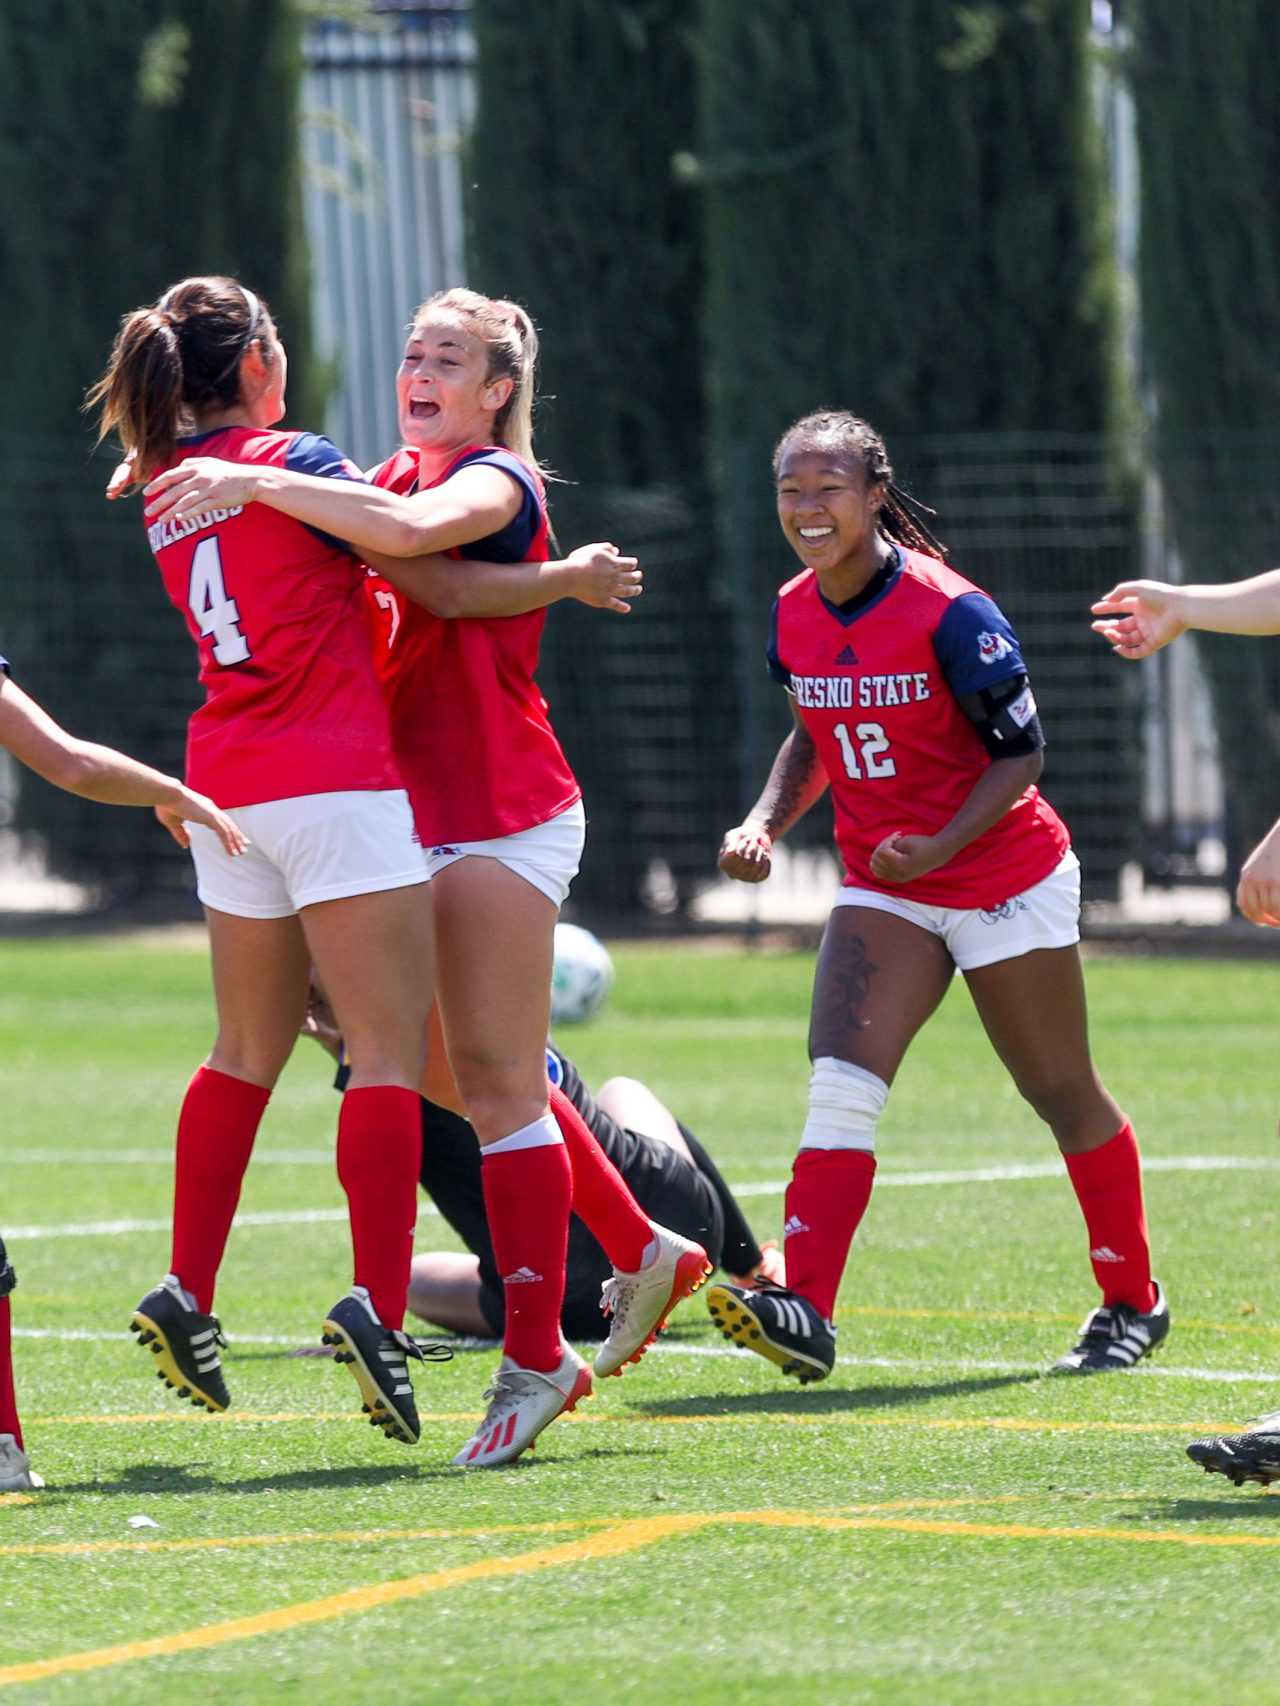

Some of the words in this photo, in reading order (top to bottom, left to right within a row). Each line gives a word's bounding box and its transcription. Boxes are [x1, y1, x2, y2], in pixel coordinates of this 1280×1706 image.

[188, 534, 252, 666] 4
[857, 672, 931, 709] STATE
[833, 722, 897, 780] 12
